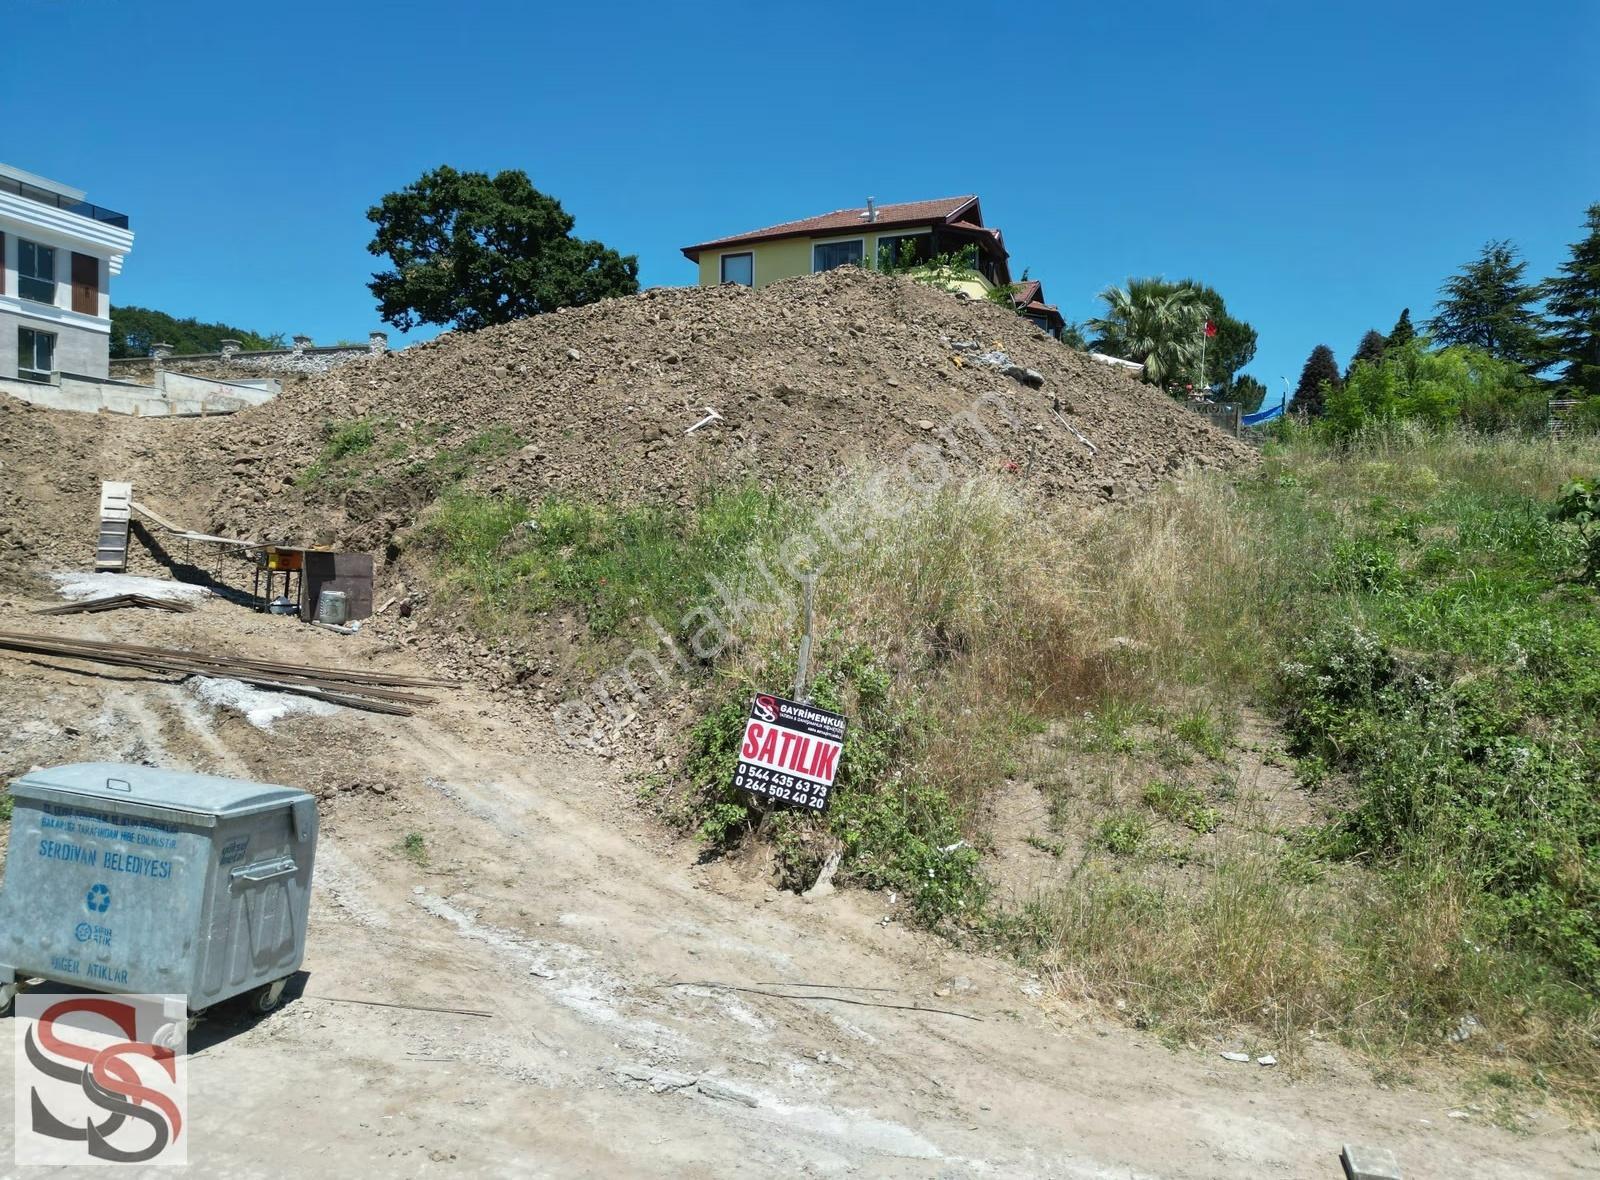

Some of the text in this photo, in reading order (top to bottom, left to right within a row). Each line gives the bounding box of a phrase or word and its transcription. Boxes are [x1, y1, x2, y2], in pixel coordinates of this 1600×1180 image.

[780, 704, 845, 729] GAYRİMENKUL
[742, 723, 840, 781] SATILIK
[735, 775, 824, 809] 0 264 502 40 20
[738, 764, 828, 798] 0 544 435 63 73
